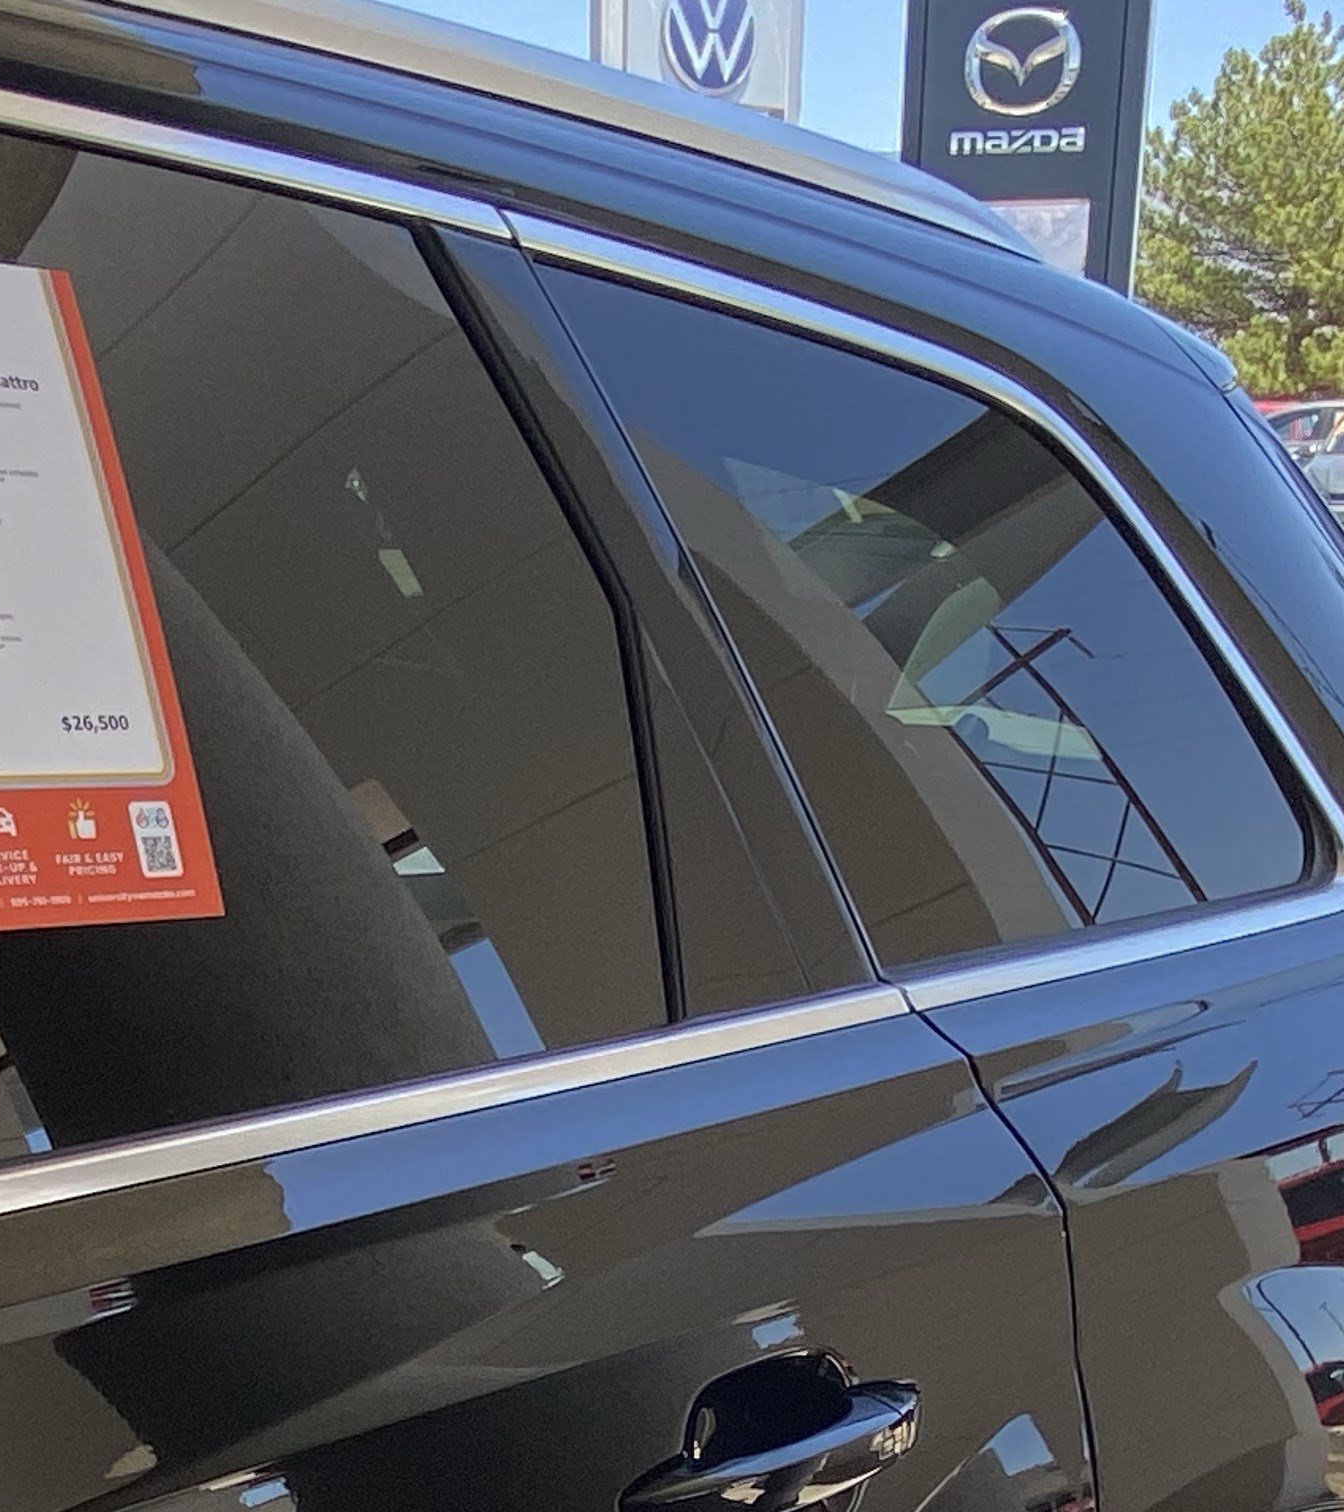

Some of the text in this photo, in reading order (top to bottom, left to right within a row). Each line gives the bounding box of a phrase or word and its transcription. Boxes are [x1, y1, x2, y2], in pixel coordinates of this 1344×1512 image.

[950, 125, 1086, 156] mazda
[61, 714, 130, 734] $26,500
[96, 852, 125, 864] EASY
